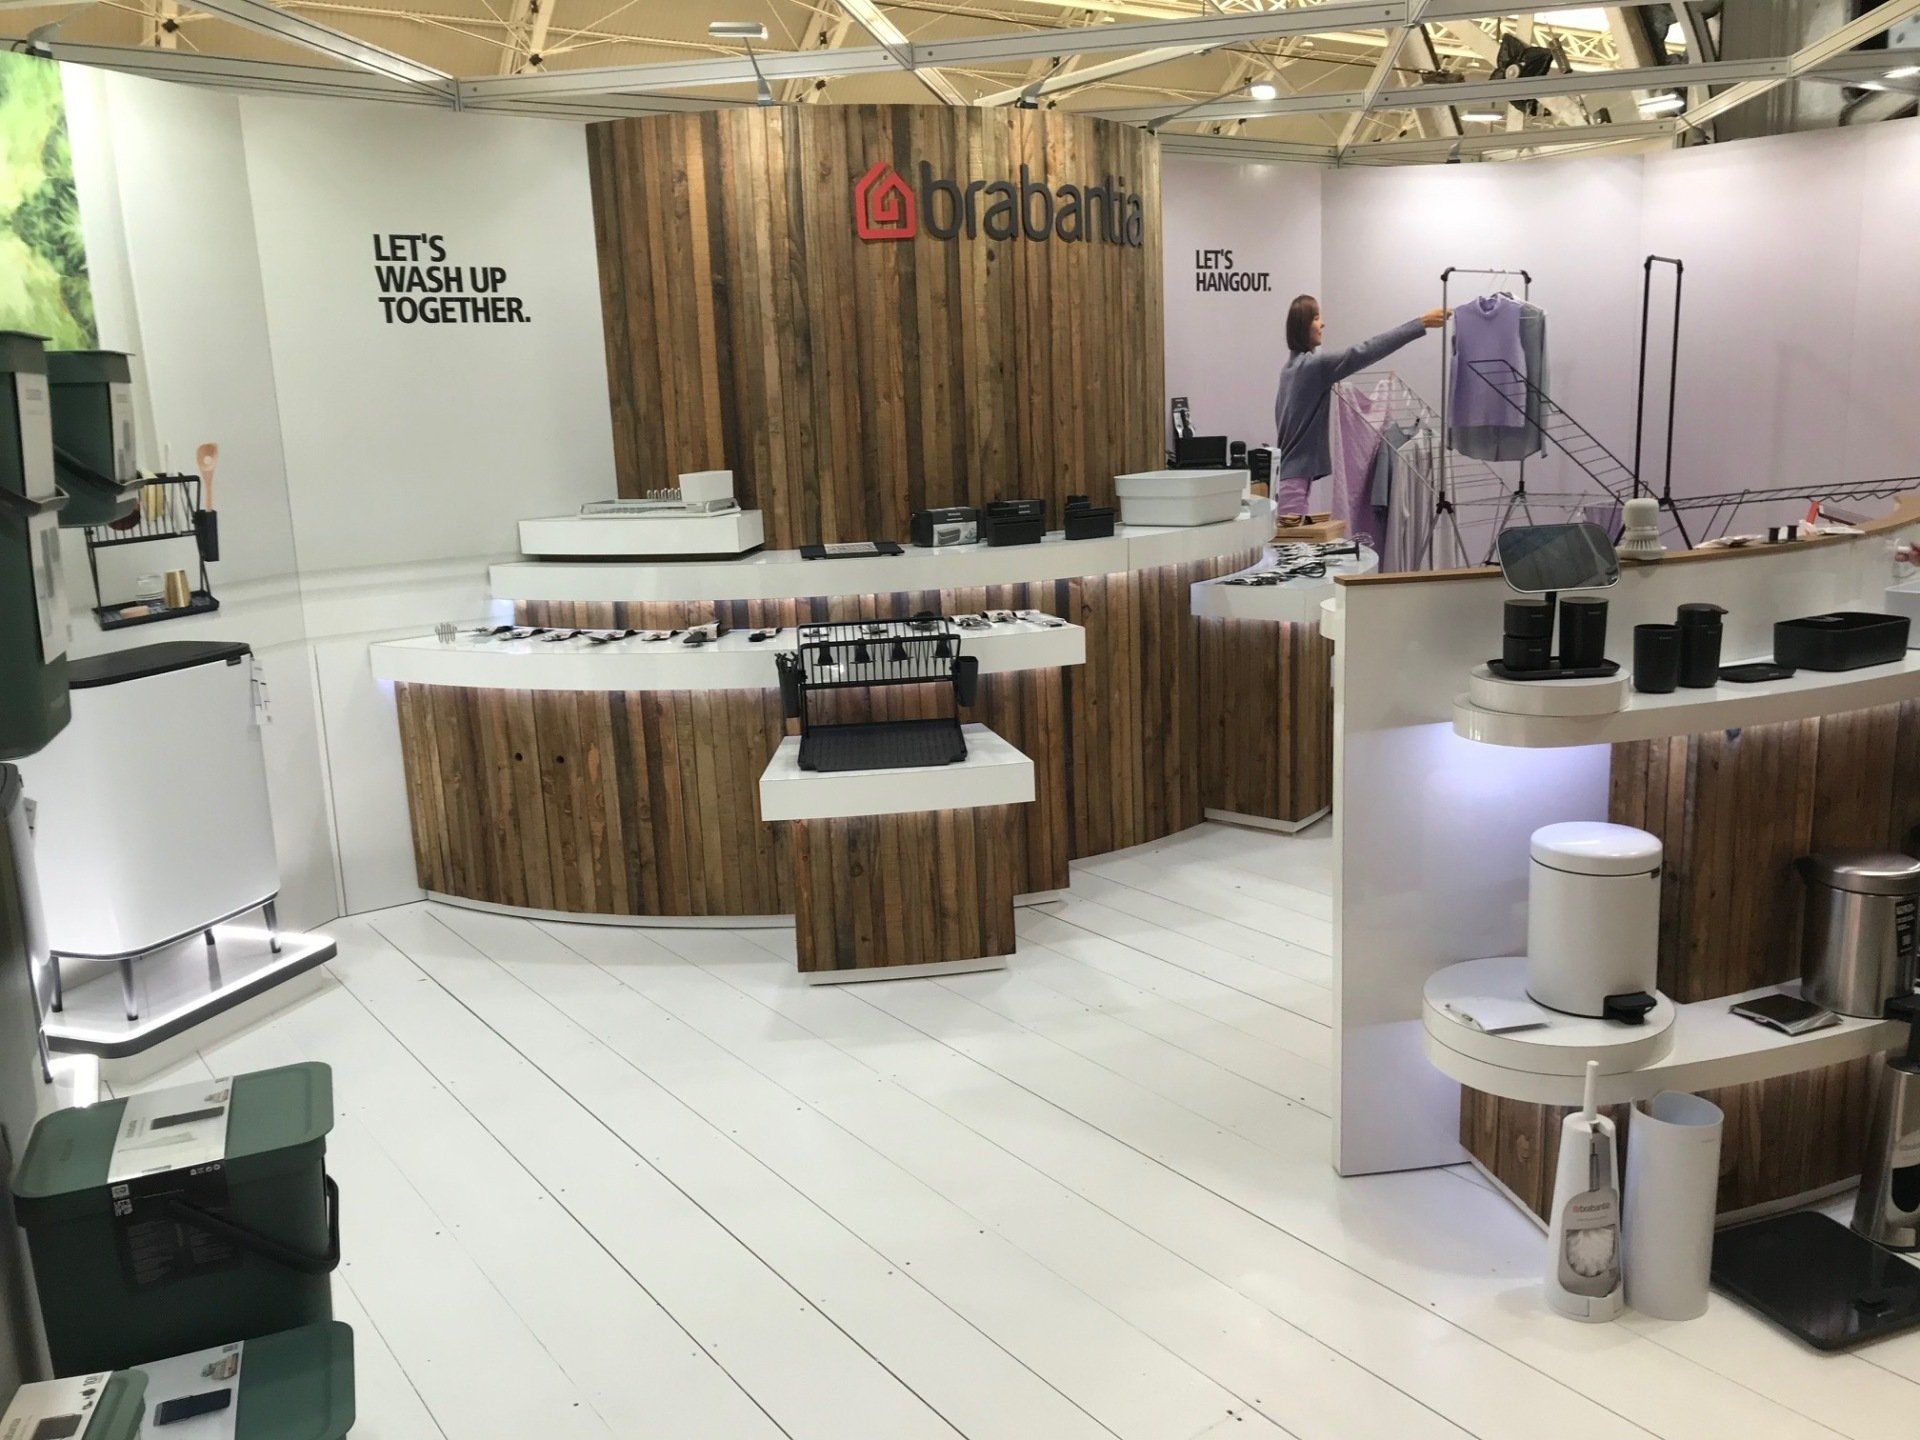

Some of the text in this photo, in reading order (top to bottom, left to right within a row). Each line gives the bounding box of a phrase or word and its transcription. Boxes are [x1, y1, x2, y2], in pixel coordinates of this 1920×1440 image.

[919, 160, 1144, 248] brabantia
[373, 233, 446, 262] LET'S
[1195, 249, 1233, 270] LET'S
[375, 265, 507, 293] WASH UP
[1196, 272, 1272, 292] HANGOUT.
[378, 296, 531, 324] TOGETHER.
